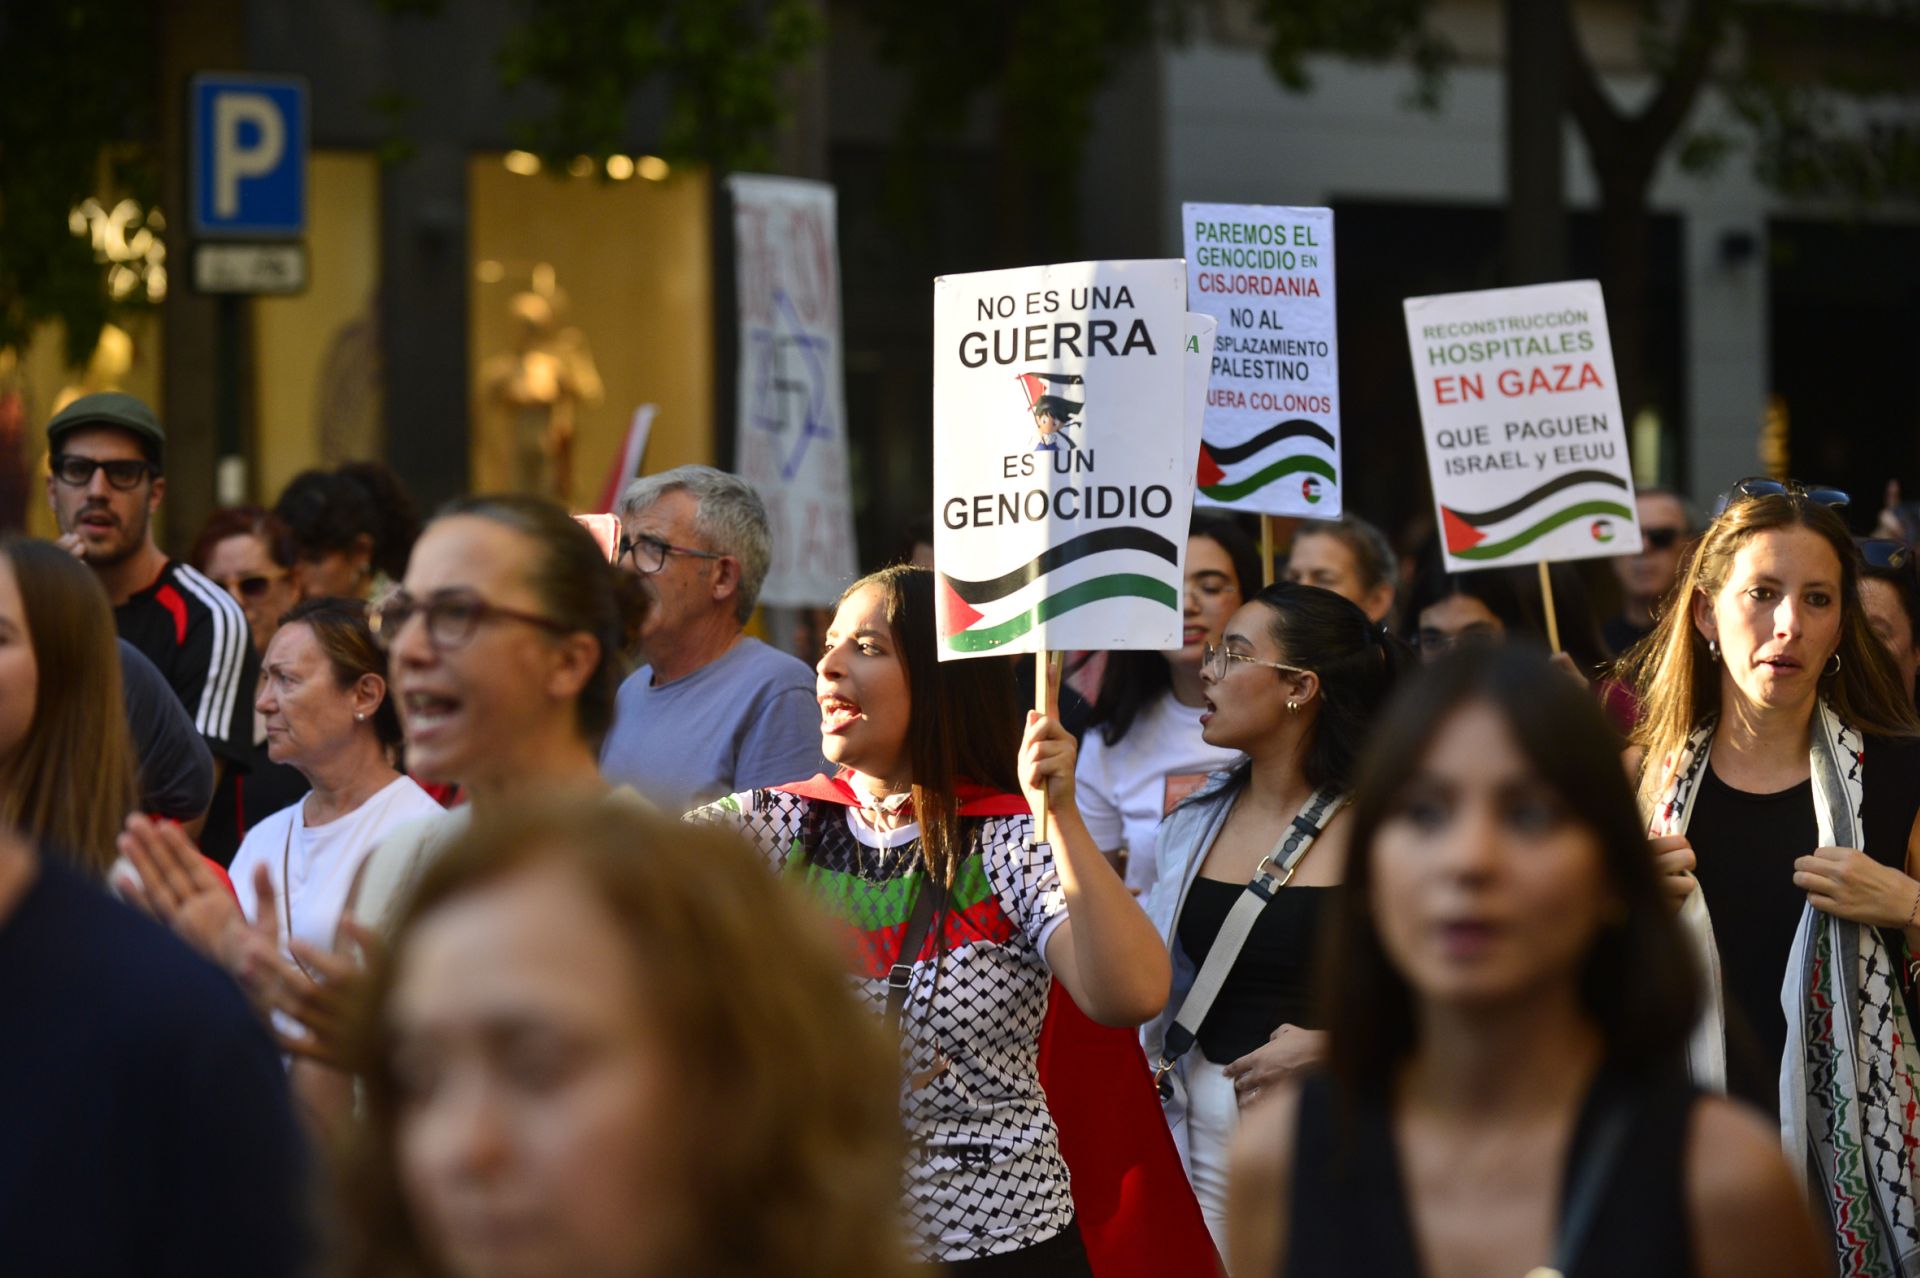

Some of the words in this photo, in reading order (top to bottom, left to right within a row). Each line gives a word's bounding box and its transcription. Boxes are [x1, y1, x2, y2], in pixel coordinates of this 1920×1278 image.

[214, 92, 287, 219] P
[1195, 221, 1286, 246] PAREMOS
[1293, 226, 1319, 246] EL
[1197, 247, 1296, 270] GENOCIDIO
[1301, 254, 1318, 268] EN
[1198, 273, 1320, 298] CISJORDANIA
[977, 295, 1016, 321] NO
[1026, 290, 1060, 315] ES
[1071, 285, 1135, 311] UNA
[1230, 308, 1254, 328] NO
[1259, 310, 1284, 330] AL
[1423, 310, 1590, 340] RECONSTRUCCIÓN
[958, 319, 1157, 369] GUERRA
[1214, 336, 1328, 357] SPLAZAMIENTO
[1427, 330, 1594, 367] HOSPITALES
[1212, 357, 1309, 381] PALESTINO
[1433, 373, 1485, 405] EN
[1497, 362, 1604, 397] GAZA
[1207, 389, 1247, 408] UERA
[1250, 392, 1331, 414] COLONOS
[1437, 425, 1491, 449] QUE
[1505, 414, 1608, 442] PAGUEN
[1003, 453, 1035, 479] ES
[1053, 449, 1095, 474] UN
[1445, 451, 1529, 475] ISRAEL
[1535, 452, 1547, 470] y
[1553, 441, 1615, 465] EEUU
[943, 484, 1173, 530] GENOCIDIO
